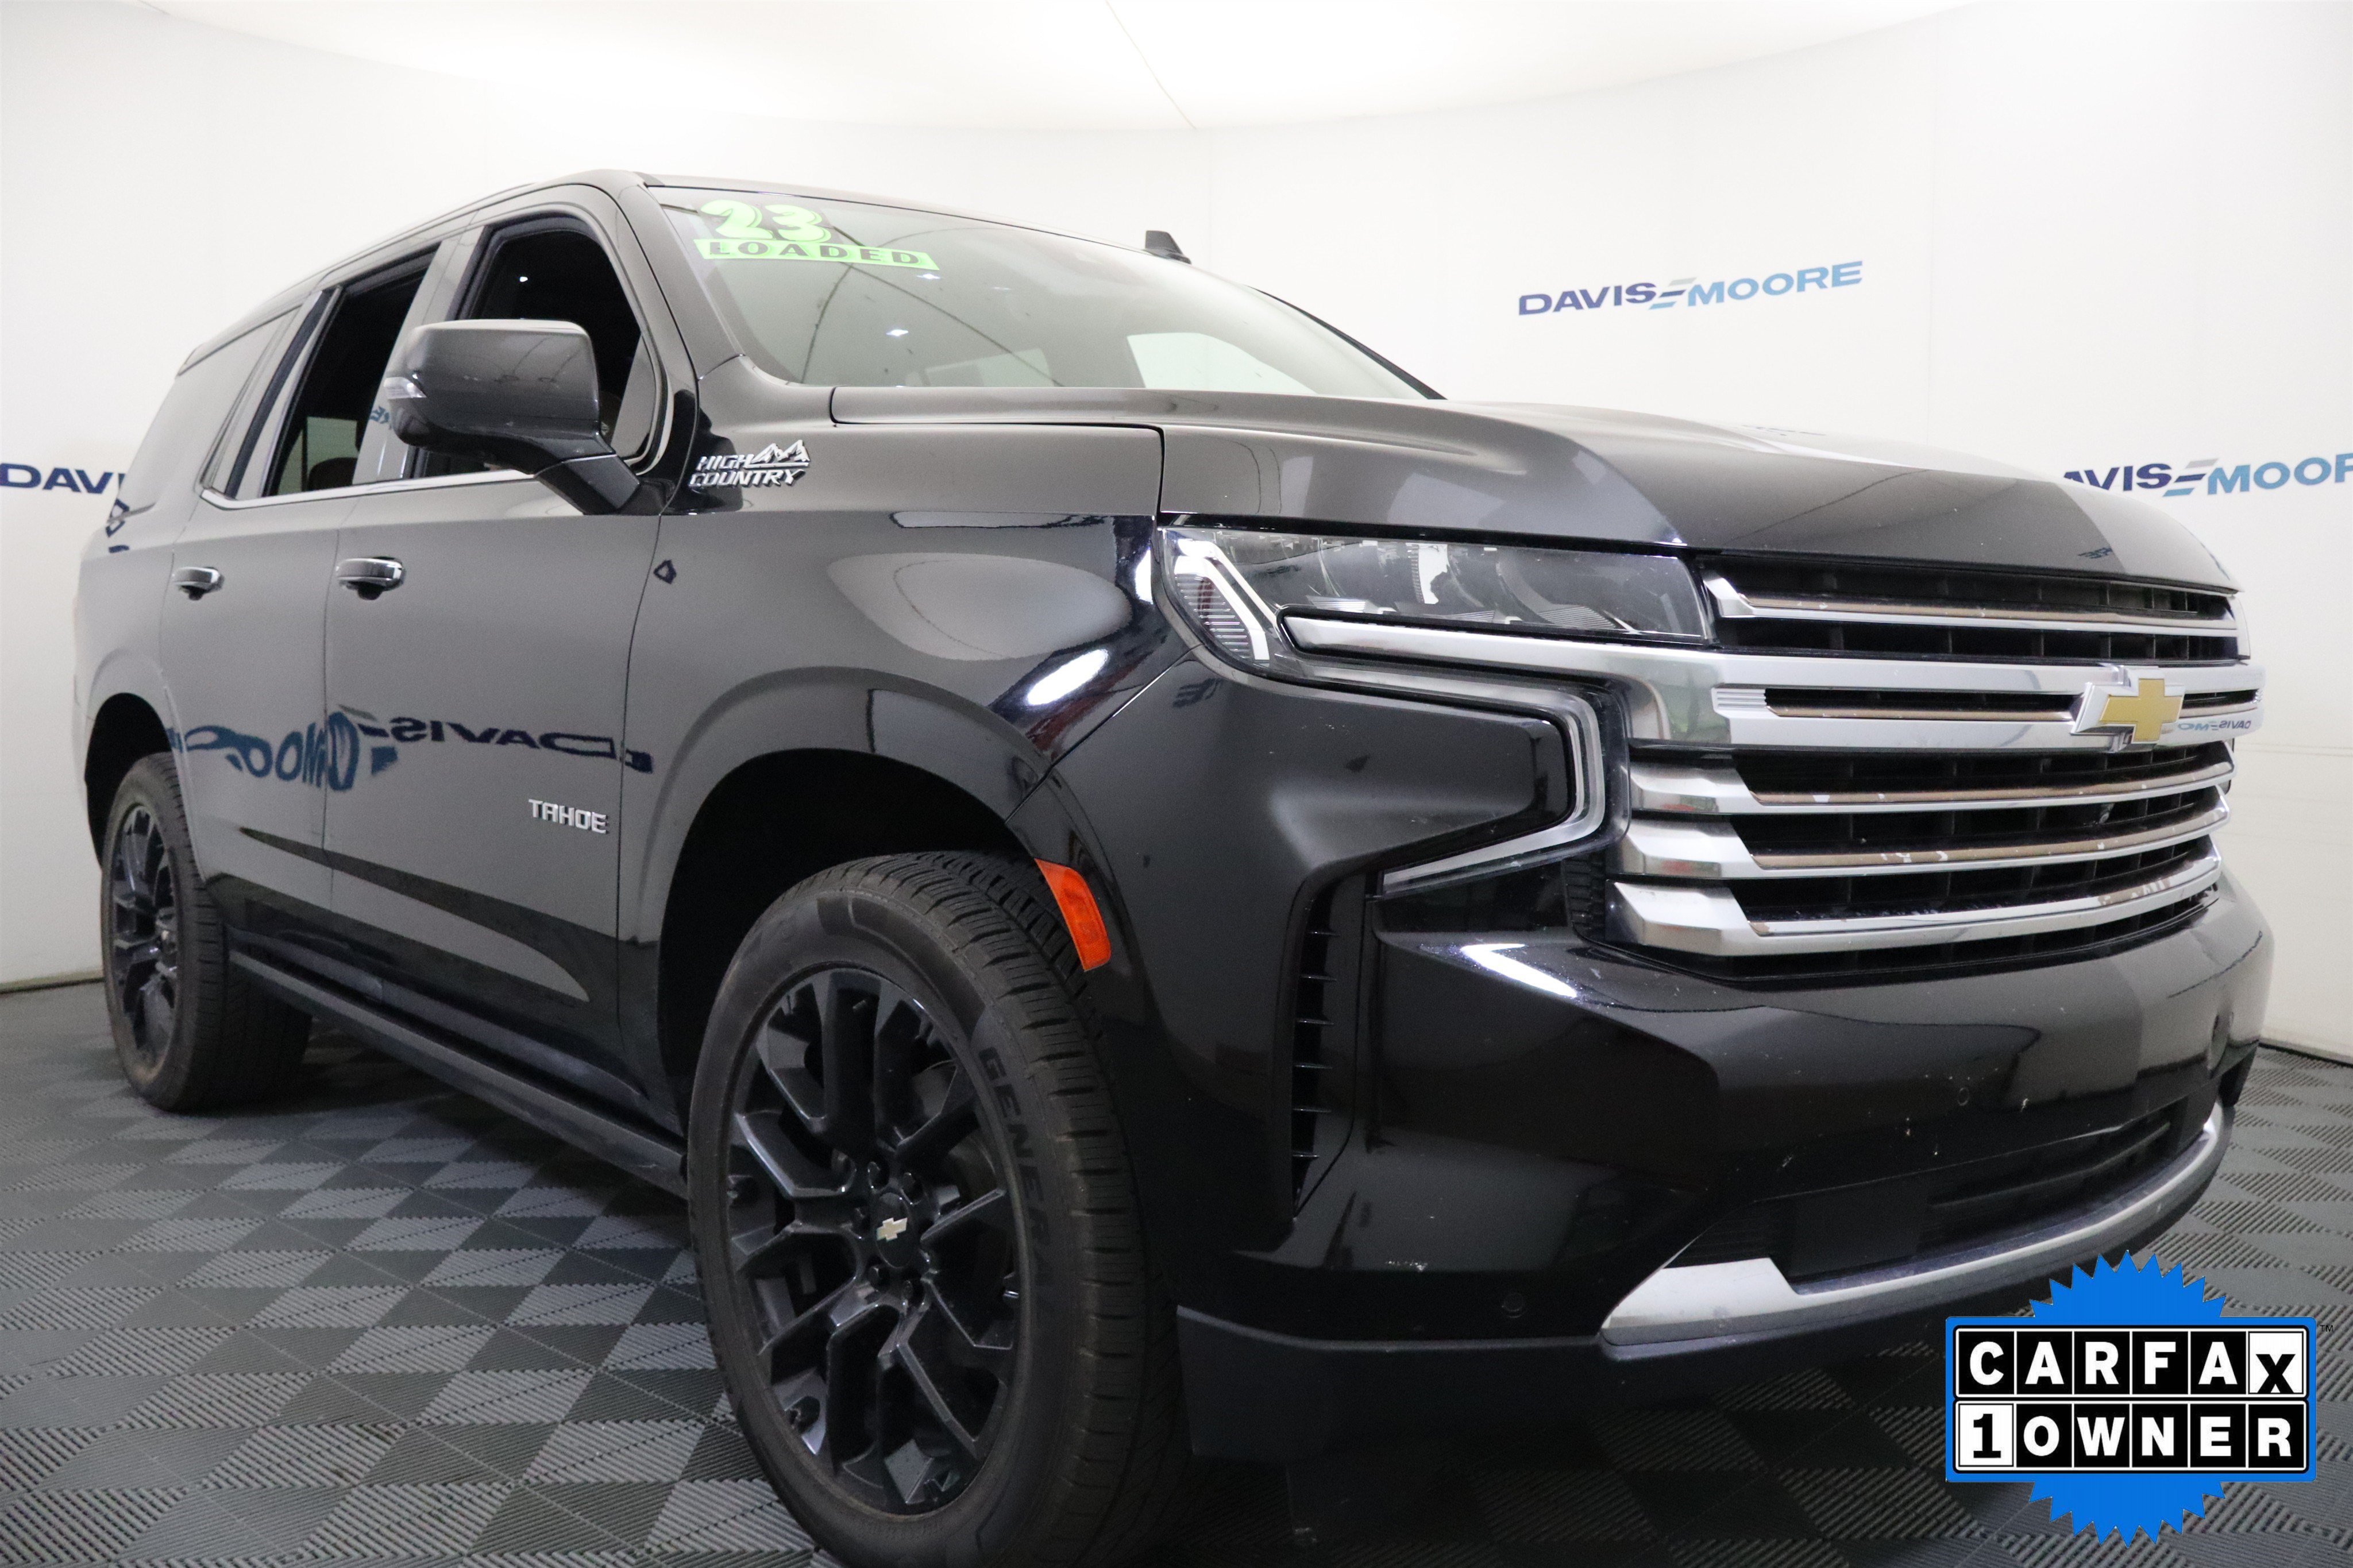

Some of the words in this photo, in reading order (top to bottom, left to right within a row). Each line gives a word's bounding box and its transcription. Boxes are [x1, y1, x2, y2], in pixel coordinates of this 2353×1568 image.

[700, 199, 831, 243] 23
[709, 241, 921, 265] LOADED
[1519, 283, 1657, 315] DAVIS
[1687, 261, 1862, 307] MOORE
[696, 454, 754, 471] HIGH
[2063, 463, 2173, 492] VIS
[0, 463, 126, 494] DAV
[689, 469, 805, 487] COUNTRY
[529, 799, 607, 833] TAHOE
